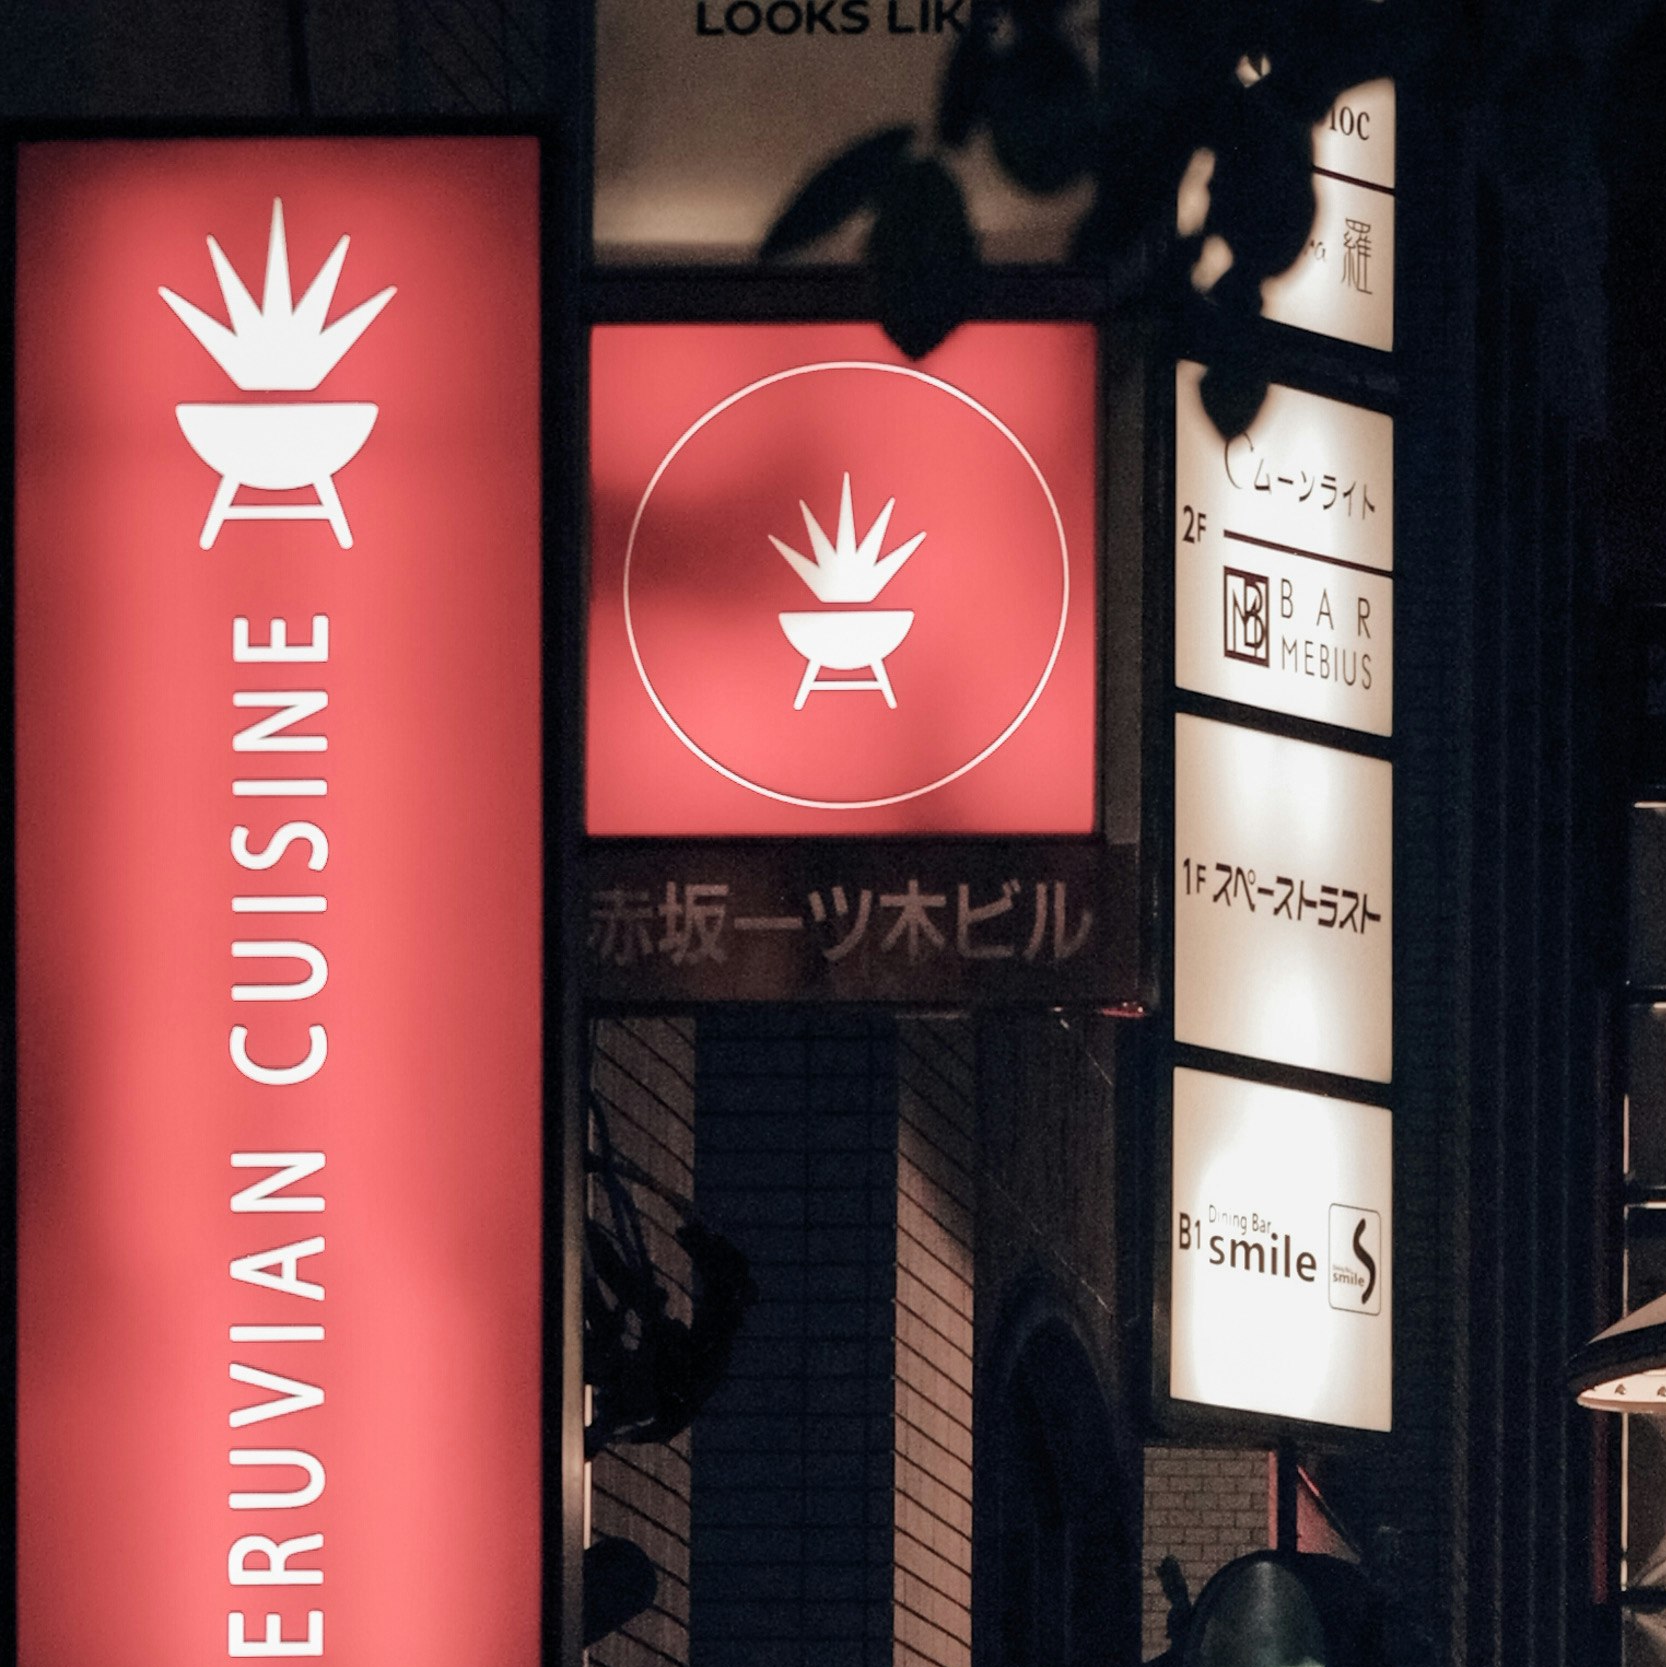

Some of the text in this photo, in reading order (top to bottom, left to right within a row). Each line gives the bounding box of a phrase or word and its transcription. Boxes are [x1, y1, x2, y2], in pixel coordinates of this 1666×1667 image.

[697, 0, 963, 35] LOOKS LIK
[1254, 458, 1376, 520] ムーンライト
[1182, 504, 1207, 544] 2F
[1280, 578, 1372, 640] BAR
[1281, 635, 1373, 690] MEBIUS
[229, 614, 330, 1086] CUISINE
[589, 879, 1094, 964] 赤坂一ツ木ビル
[1183, 857, 1382, 935] 1F スペーストラスト
[1179, 1212, 1201, 1251] B1
[1252, 1213, 1272, 1235] Bar
[1209, 1231, 1317, 1283] smile
[1332, 1269, 1366, 1288] smile
